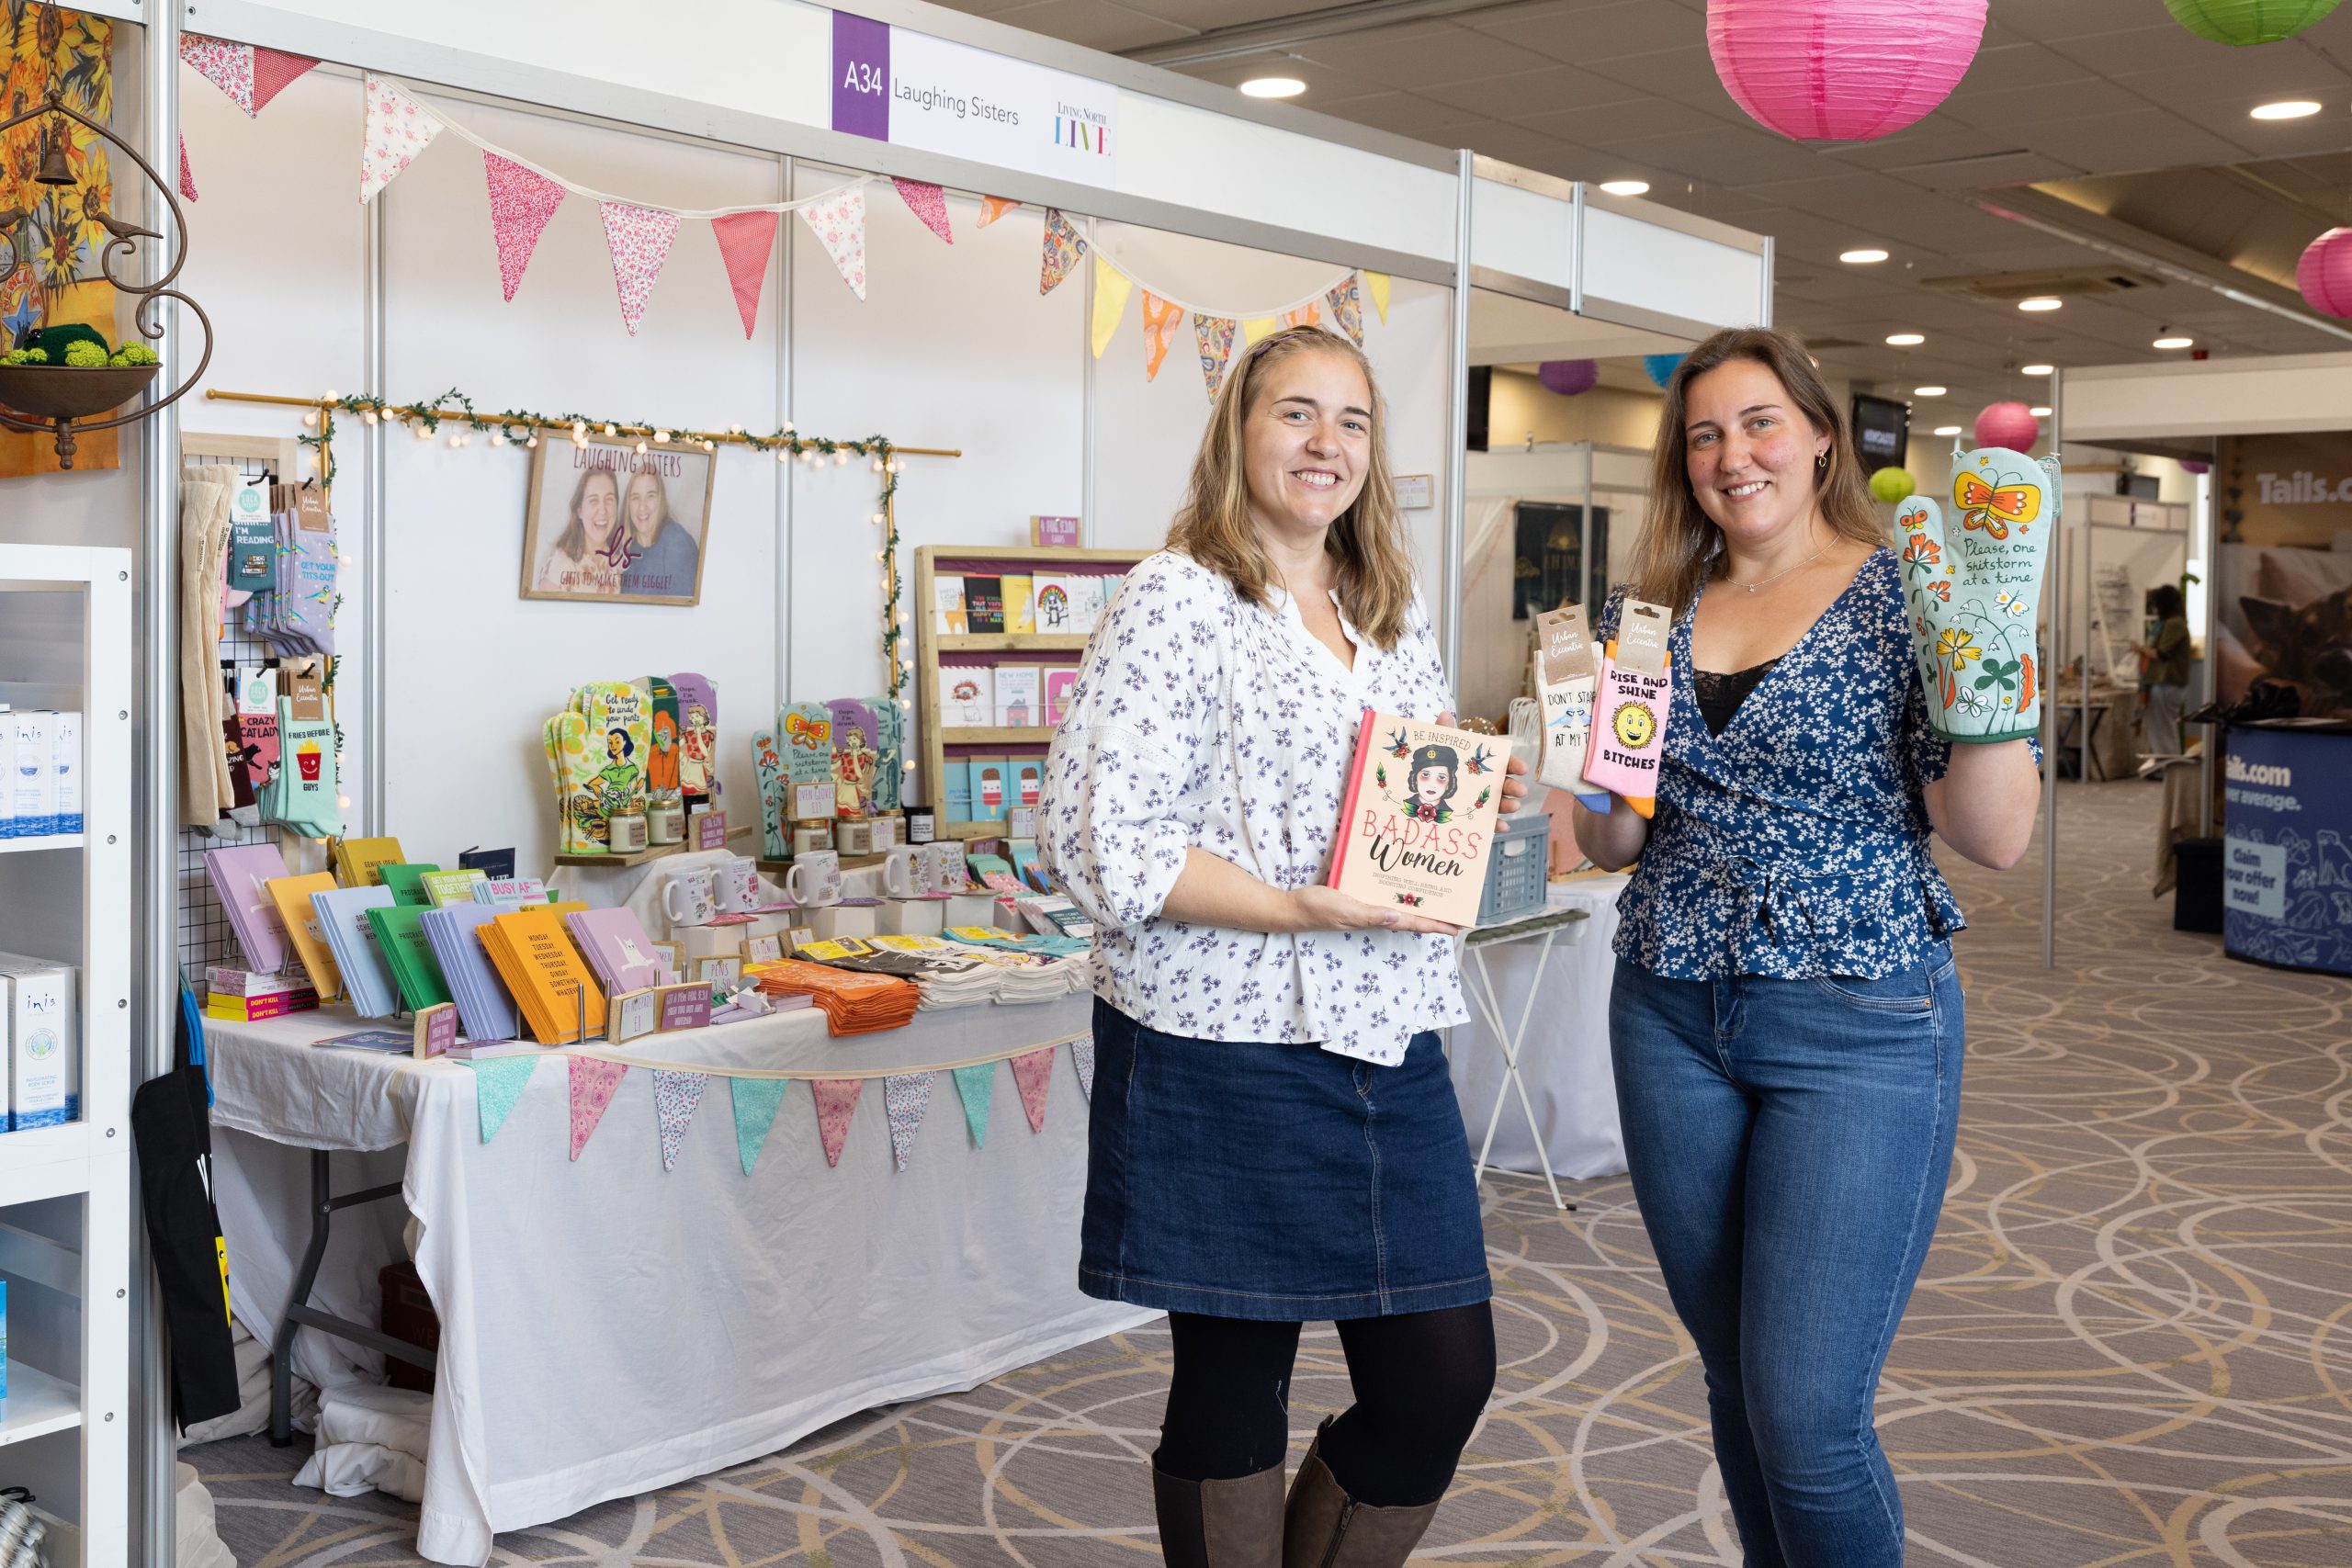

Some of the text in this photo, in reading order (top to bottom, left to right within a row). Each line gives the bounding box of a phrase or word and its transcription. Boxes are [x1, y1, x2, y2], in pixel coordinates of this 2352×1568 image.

[843, 61, 883, 96] A34
[894, 77, 1020, 126] Laughing Sisters
[1057, 101, 1106, 125] LIVING NORTH
[1054, 116, 1112, 157] LIVE
[573, 446, 682, 478] LAUGHING SISTERS
[236, 536, 275, 544] READING
[1964, 538, 2037, 558] Please, one
[301, 561, 336, 571] GET YOUR
[1966, 558, 2032, 572] shitstorm
[301, 571, 335, 581] TITS OUT
[560, 570, 580, 586] GIFTS
[620, 573, 639, 588] THEM
[642, 574, 673, 590] GIGGLE!
[1962, 575, 1978, 586] at
[1996, 572, 2034, 584] time
[1631, 623, 1657, 637] Urban
[1553, 631, 1578, 645] Urban
[1551, 641, 1584, 658] Eccentric
[1611, 671, 1668, 688] RISE AND
[1548, 692, 1573, 706] DON'T
[1618, 685, 1657, 700] SHINE
[605, 694, 639, 708] Get ready
[608, 705, 633, 715] to undo
[247, 716, 276, 726] CRAZY
[605, 715, 640, 728] your pants
[17, 726, 42, 742] inis
[241, 727, 279, 738] CAT LADY
[288, 728, 331, 739] FRIES BEFORE
[1414, 730, 1471, 751] BE INSPIRED
[1555, 733, 1582, 747] AT MY
[227, 753, 243, 763] ZING
[1603, 749, 1656, 770] BITCHES
[2225, 754, 2291, 787] ails.com
[303, 783, 319, 792] GUYS
[2241, 790, 2301, 812] average.
[1025, 811, 1036, 823] CA
[1363, 809, 1483, 860] BADASS
[1370, 834, 1464, 876] Women
[2233, 848, 2261, 867] Claim
[1373, 872, 1402, 882] INSPIRING
[2226, 867, 2276, 889] our offer
[401, 888, 426, 897] PROCRAST
[491, 881, 531, 896] BUSY AF
[1378, 879, 1444, 897] BOOSTING CONFIDENCE
[2233, 887, 2259, 905] now!
[356, 913, 368, 921] DRE
[356, 923, 371, 931] SCHE
[398, 931, 424, 939] PROCRAST
[528, 933, 550, 942] MONDAY.
[413, 940, 428, 948] CENT
[532, 942, 556, 951] TUESDAY.
[534, 951, 565, 961] WEDNESDAY.
[540, 960, 569, 969] THURSDAY.
[711, 964, 729, 976] PENS
[549, 977, 579, 988] SOMETHING
[555, 987, 580, 997] WHATEVE
[27, 993, 56, 1012] inis
[251, 998, 267, 1007] DON'T
[252, 1010, 268, 1019] DON'T
